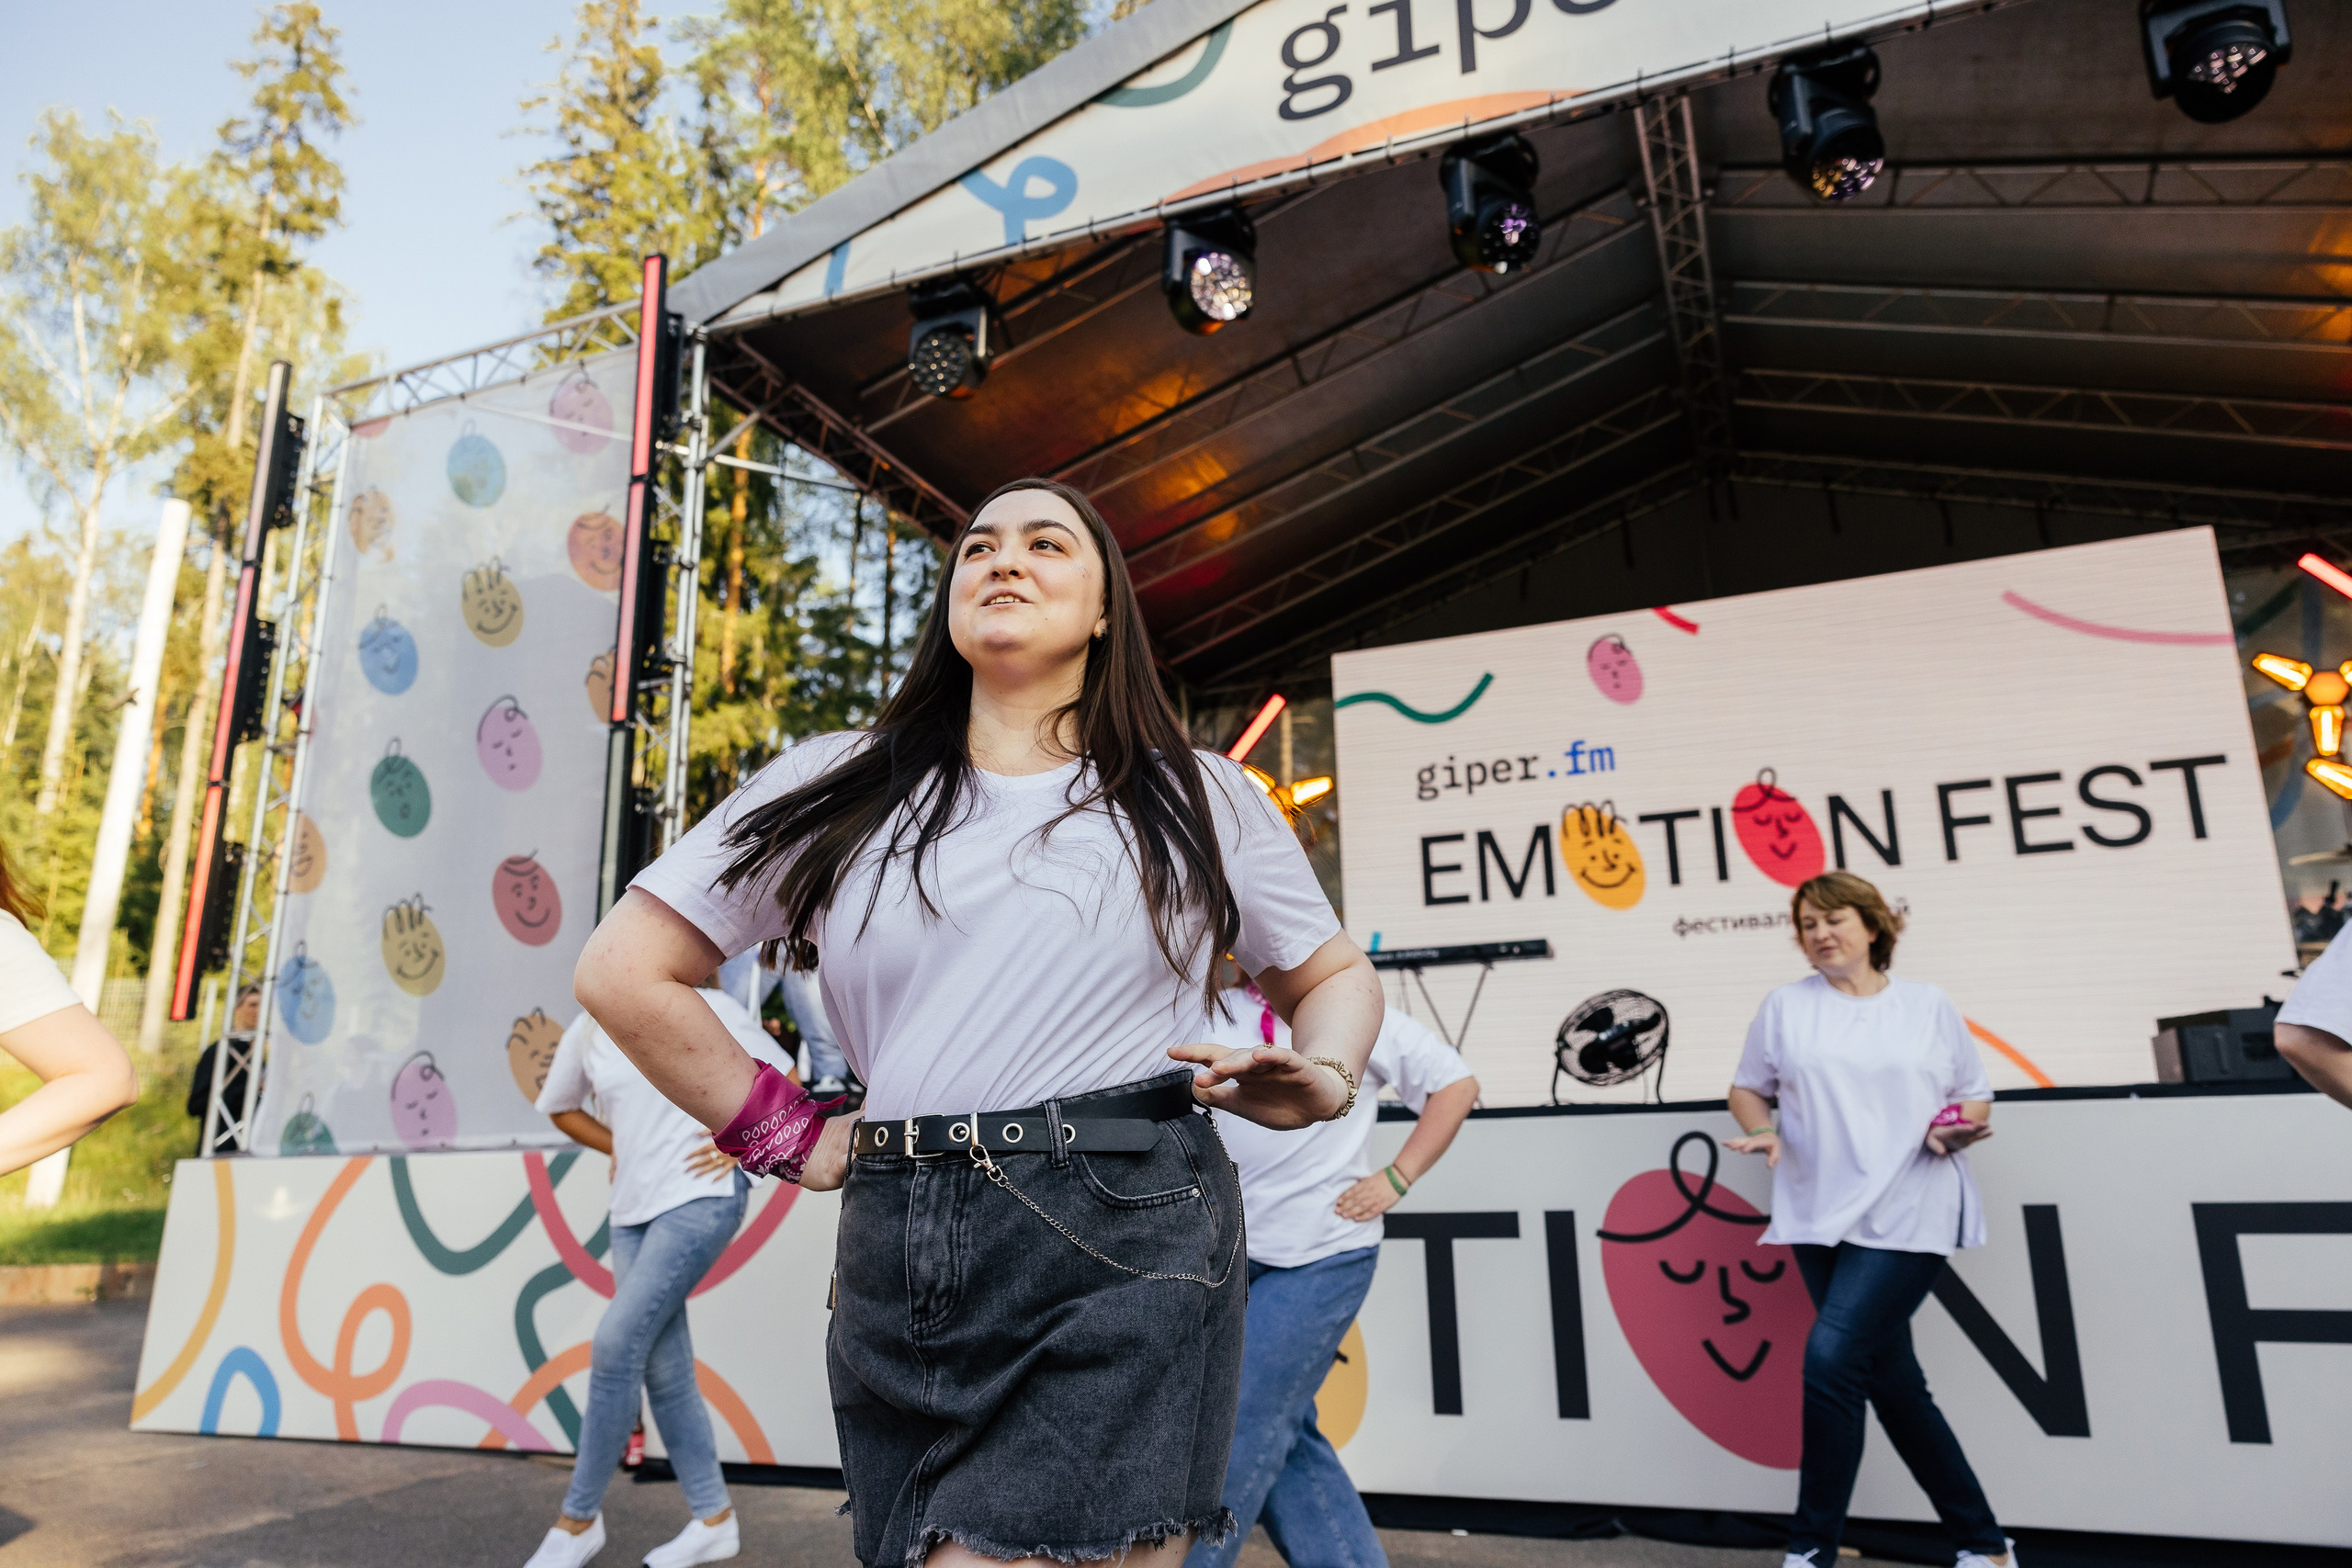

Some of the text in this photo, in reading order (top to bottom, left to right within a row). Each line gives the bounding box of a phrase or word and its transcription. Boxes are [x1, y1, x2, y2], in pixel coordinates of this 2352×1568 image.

[1278, 0, 1621, 120] gip
[1417, 739, 1616, 801] giper.fm
[1936, 754, 2227, 863] FEST
[1672, 912, 1792, 938] фестивал
